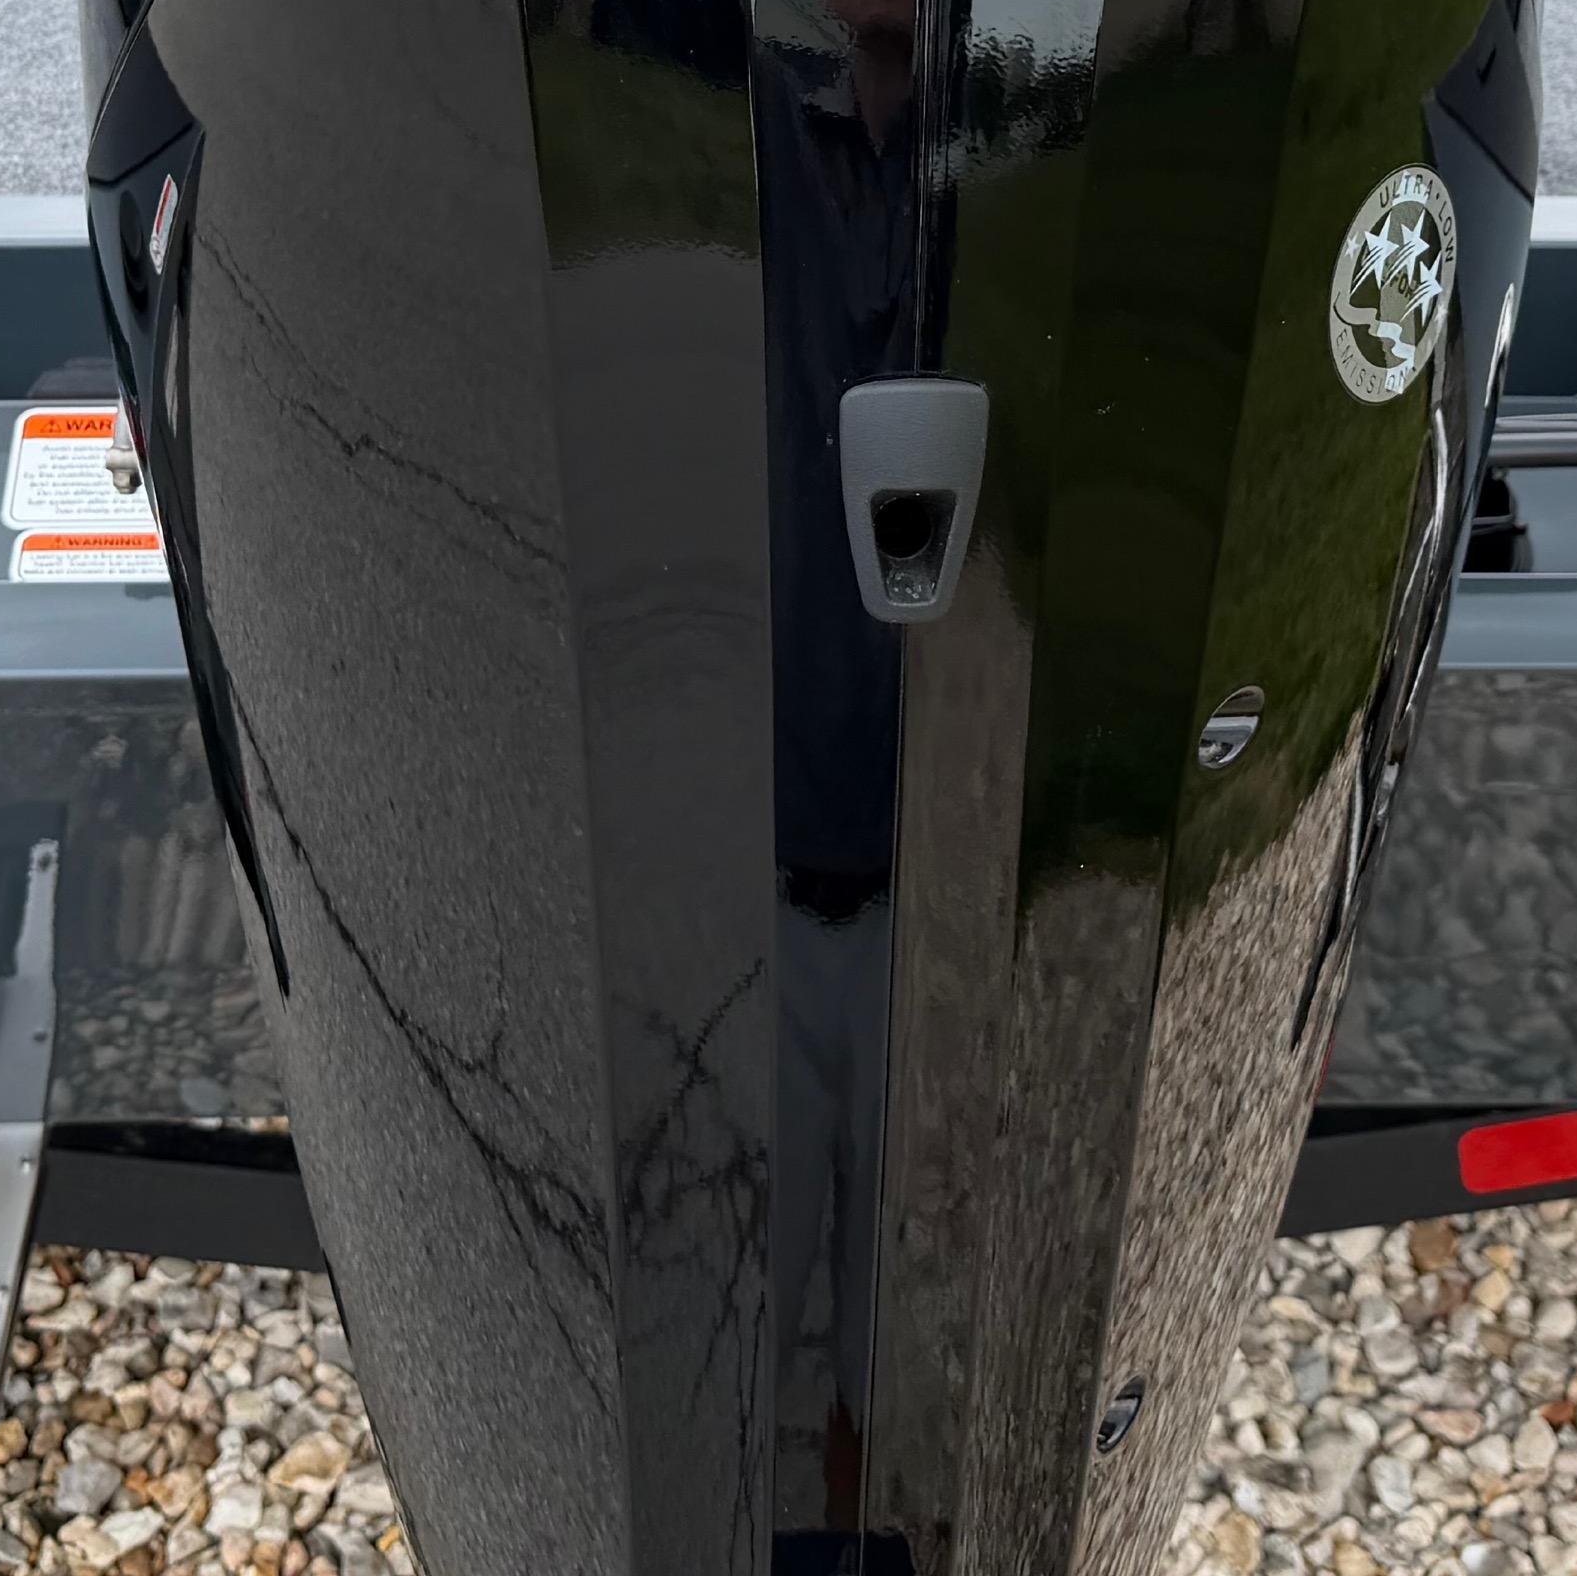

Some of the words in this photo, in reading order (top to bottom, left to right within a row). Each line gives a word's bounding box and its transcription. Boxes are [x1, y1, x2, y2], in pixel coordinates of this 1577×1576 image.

[1378, 172, 1434, 209] ULTRA
[1436, 200, 1455, 264] LOW
[1334, 327, 1410, 395] EMISSION
[67, 535, 143, 547] WARNING
